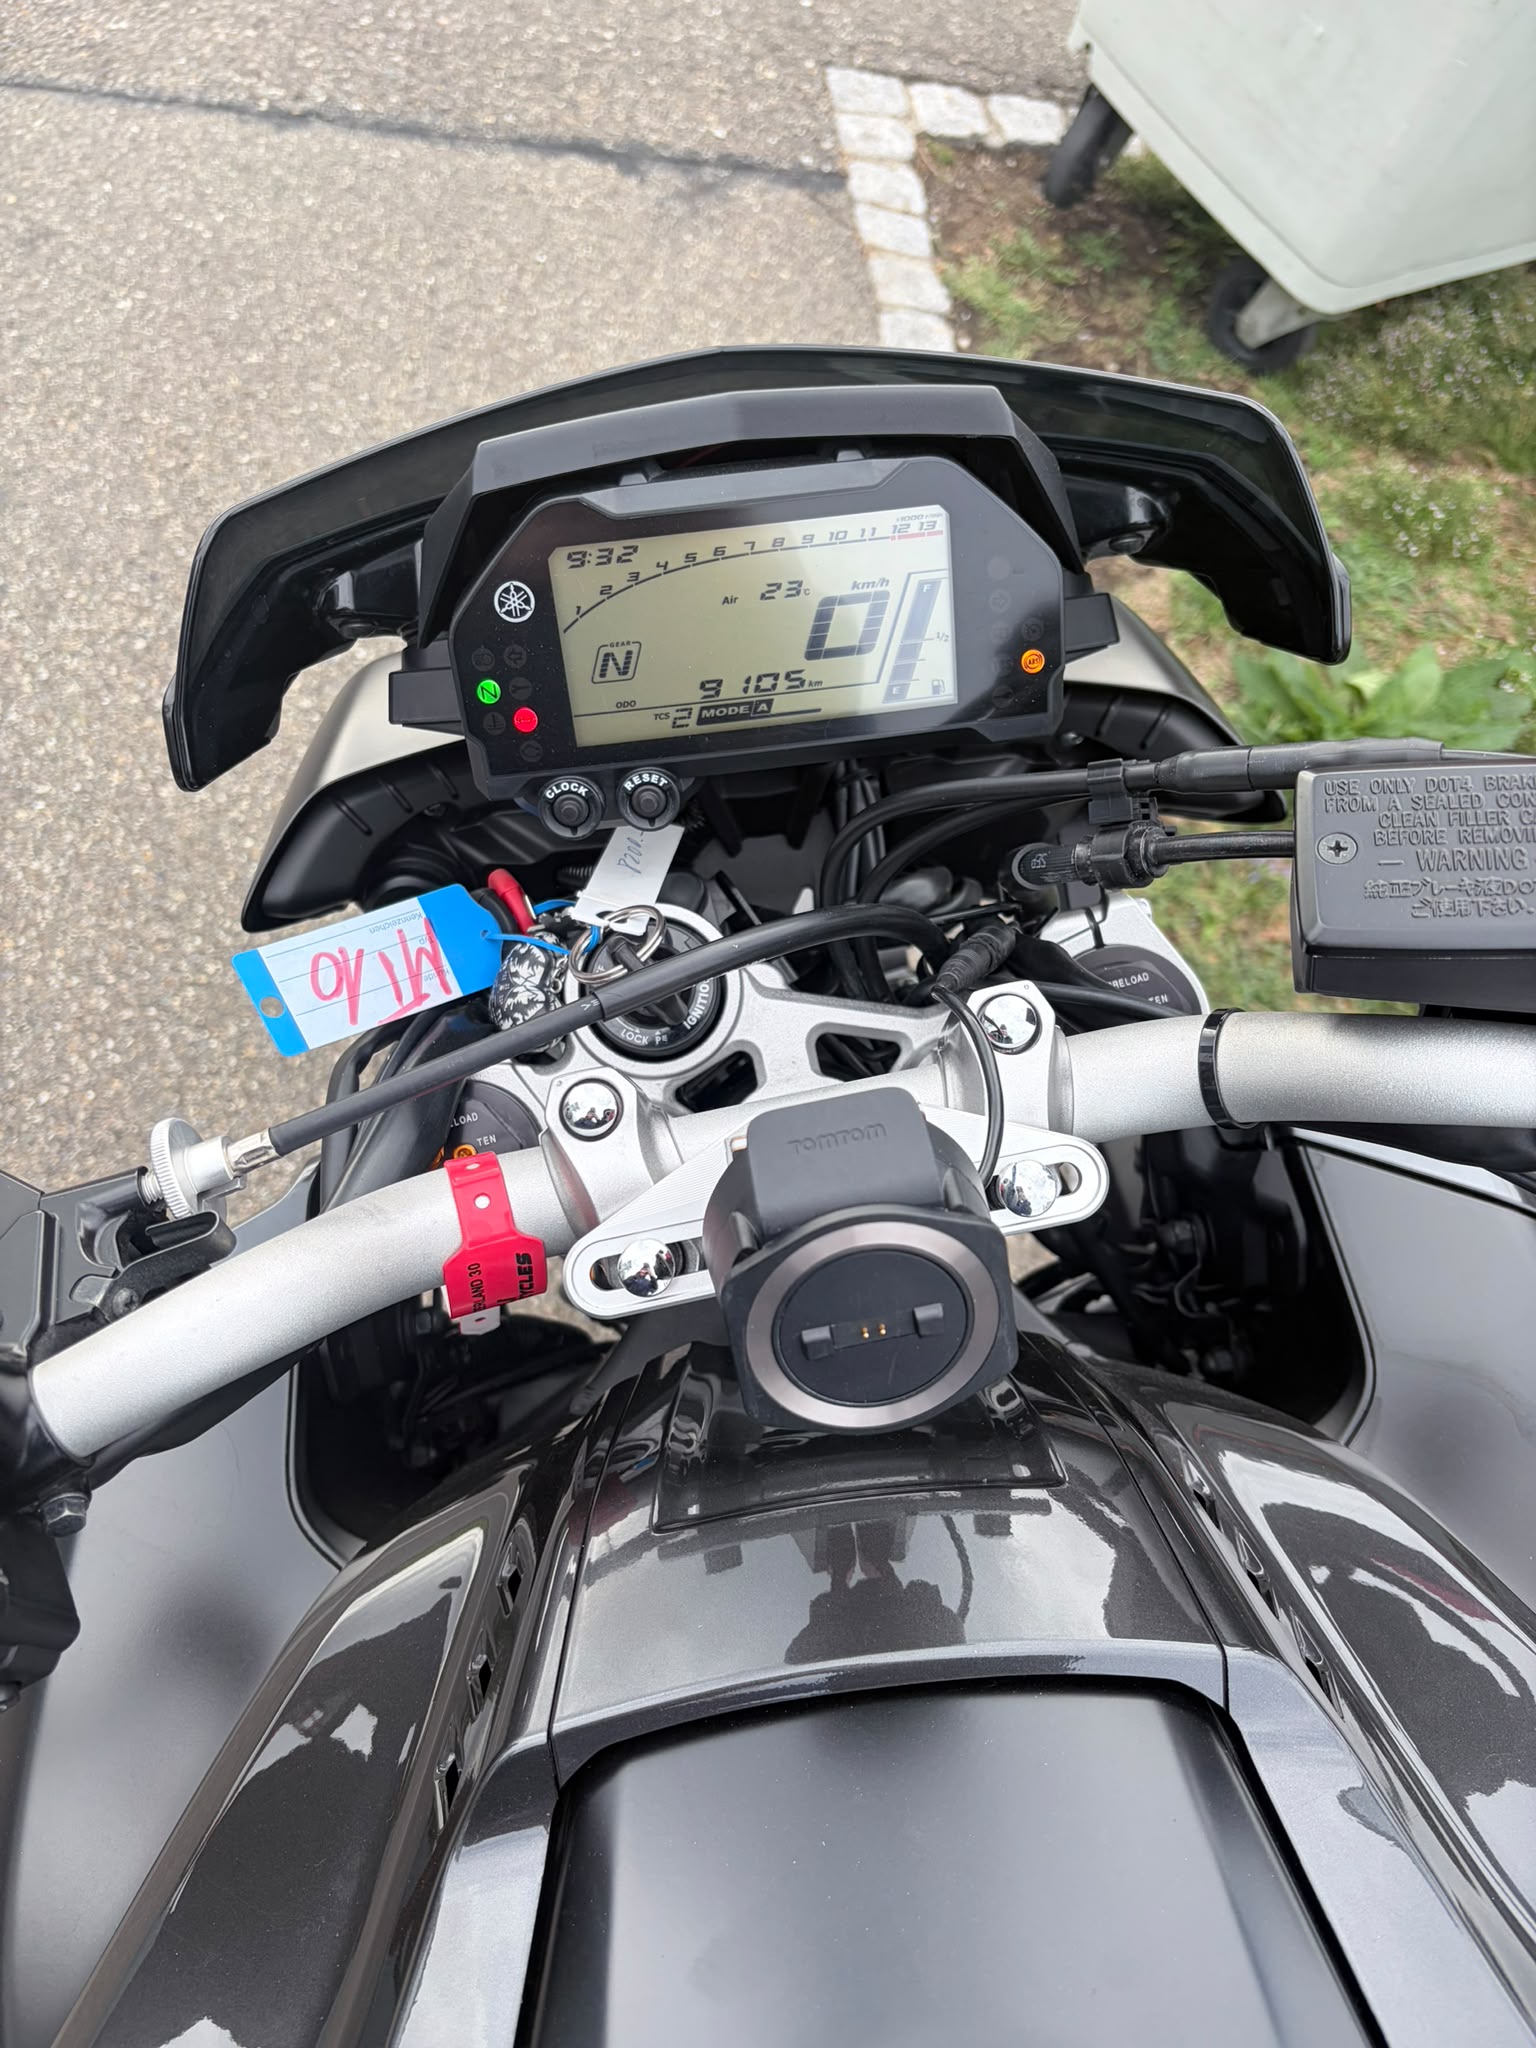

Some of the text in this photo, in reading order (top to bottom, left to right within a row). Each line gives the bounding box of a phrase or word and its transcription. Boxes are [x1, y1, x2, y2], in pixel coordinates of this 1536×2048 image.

[567, 545, 639, 569] 9:32
[575, 520, 938, 615] 1 2 3 4 5 6 7 8 9 10 11 12 13
[722, 595, 739, 605] Air
[760, 580, 803, 601] 23
[851, 577, 890, 591] km/h
[923, 583, 931, 593] F
[804, 590, 891, 661] 0
[609, 640, 632, 648] GEAR
[599, 650, 633, 678] N
[480, 684, 498, 700] N
[808, 680, 823, 688] km
[892, 687, 901, 695] E
[616, 700, 637, 709] ODO
[654, 703, 769, 729] TCS 2 MODE A
[545, 782, 589, 799] CLOCK
[623, 773, 668, 791] RESET
[1324, 780, 1361, 796] USE
[1370, 777, 1415, 795] ONLY
[1425, 776, 1473, 793] DOT4
[1324, 796, 1379, 813] FROM
[1388, 795, 1403, 812] A
[1411, 793, 1485, 811] SEALED
[1378, 809, 1536, 829] CLEAN FILLER C
[1373, 826, 1536, 846] BEFORE REMOVI
[1416, 847, 1529, 872] WARNING
[369, 910, 423, 934] Kennzeichen
[1108, 971, 1149, 990] RELOAD
[682, 977, 711, 1031] IGNITIO
[620, 1028, 650, 1046] LOCK
[450, 1112, 479, 1129] LOAD
[476, 1134, 497, 1147] TEN
[467, 1263, 481, 1277] 30
[515, 1252, 534, 1300] YCLES
